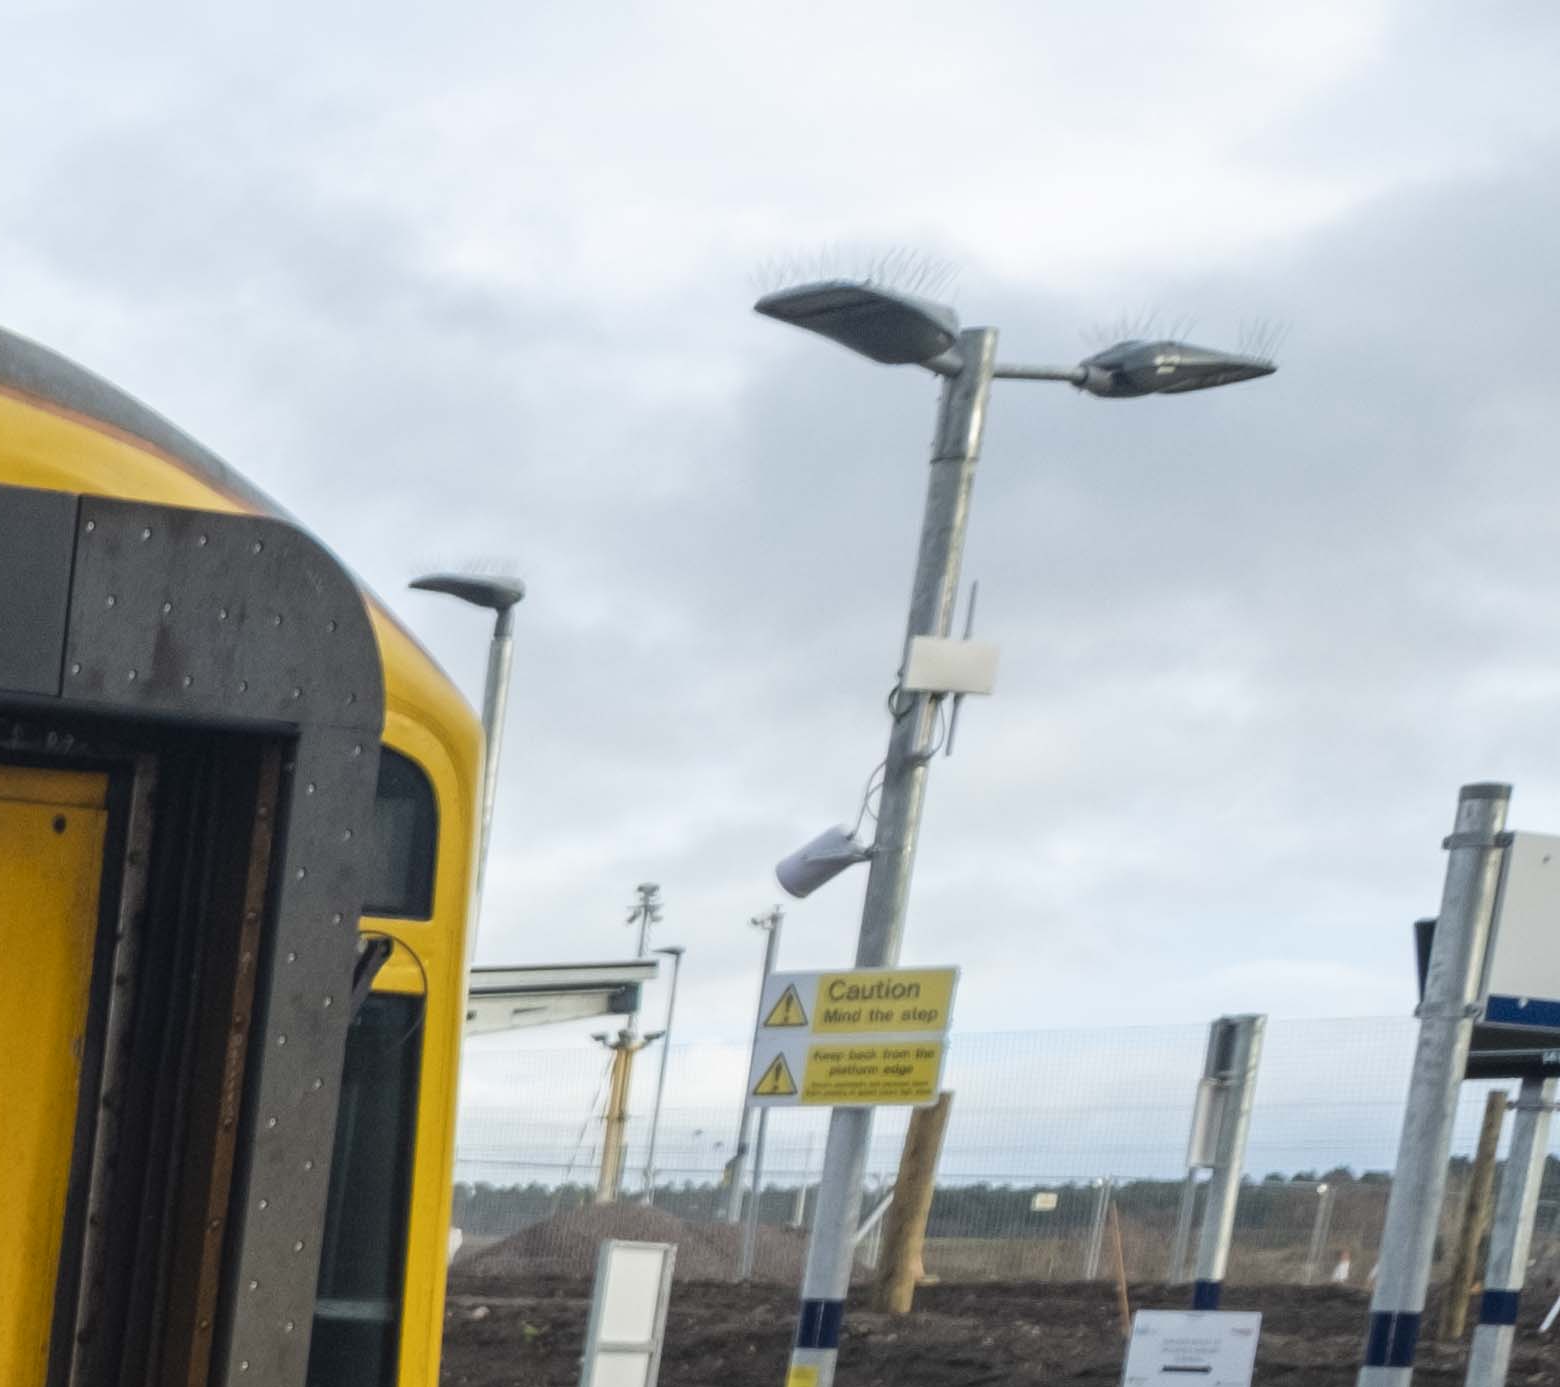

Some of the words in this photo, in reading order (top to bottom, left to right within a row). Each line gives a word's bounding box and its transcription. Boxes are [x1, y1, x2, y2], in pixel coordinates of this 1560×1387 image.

[828, 979, 921, 1001] Caution
[823, 1009, 861, 1024] Mind
[869, 1009, 894, 1022] the
[901, 1008, 939, 1023] step
